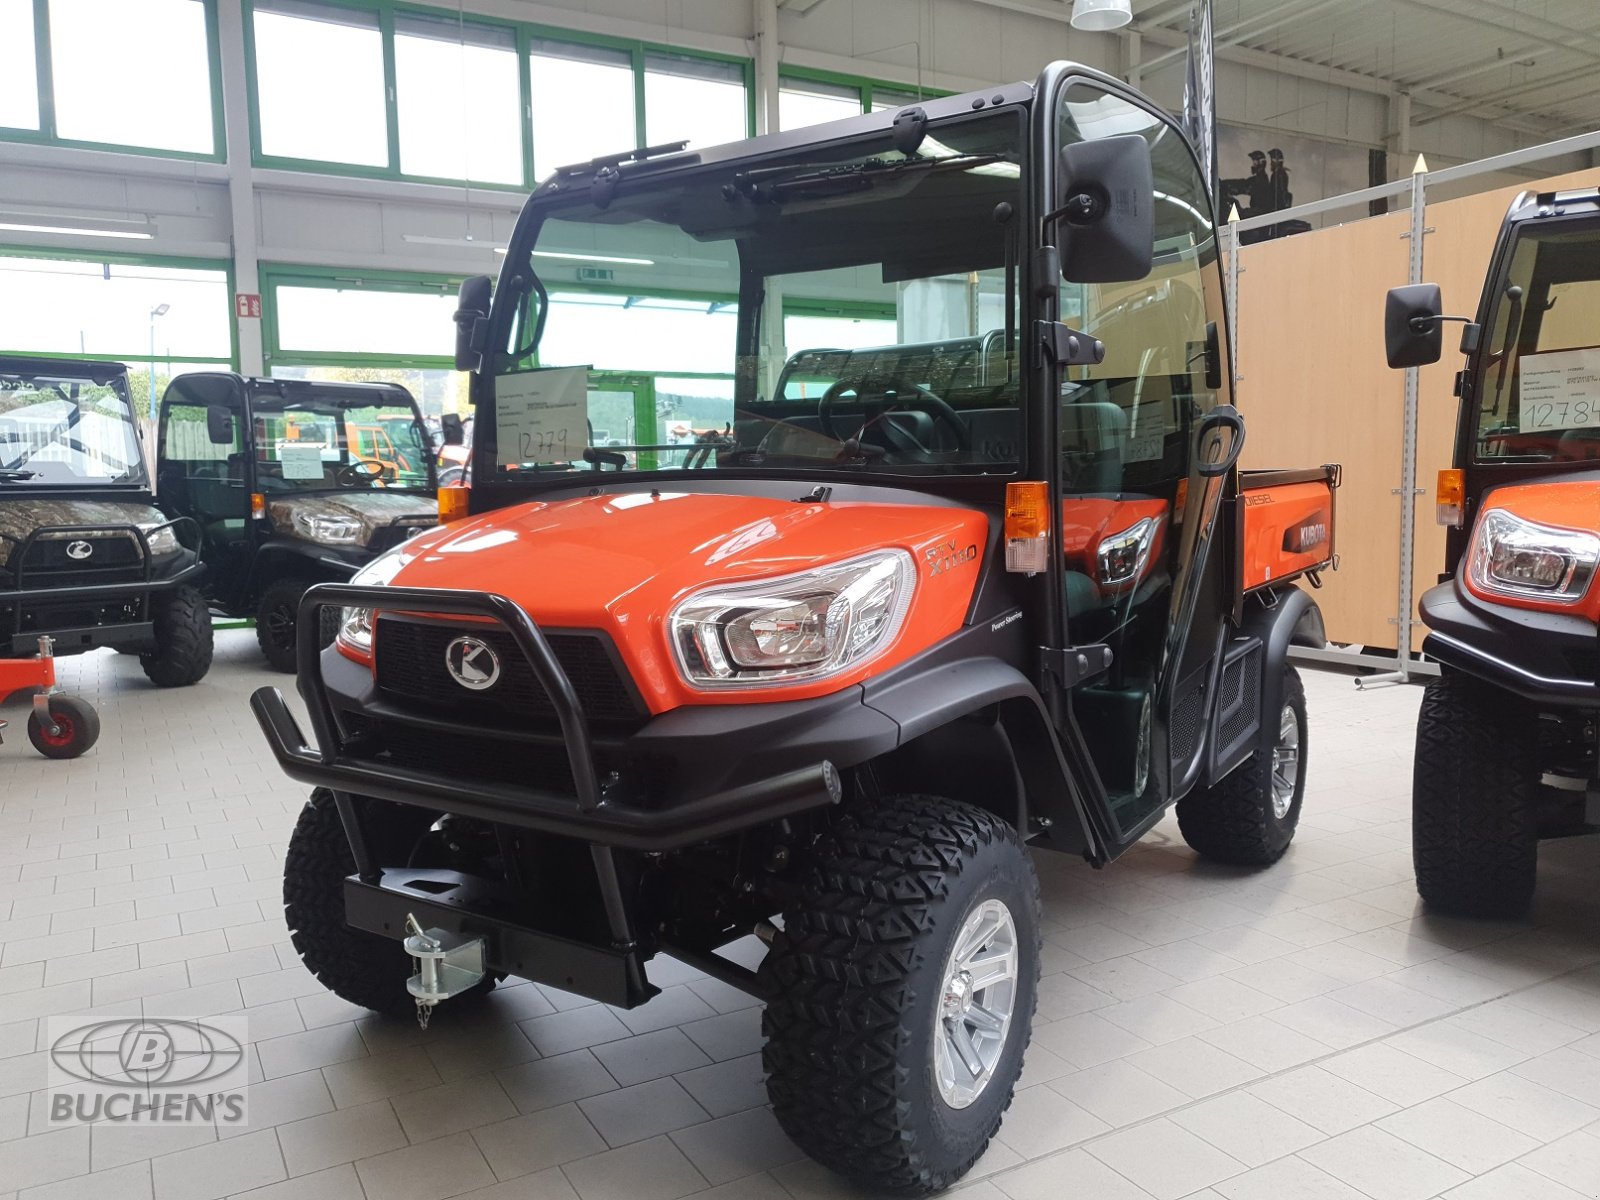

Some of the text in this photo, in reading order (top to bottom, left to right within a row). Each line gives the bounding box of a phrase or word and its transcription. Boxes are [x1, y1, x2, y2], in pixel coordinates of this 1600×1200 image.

[1524, 400, 1600, 428] 12784
[519, 428, 568, 460] 12779
[1245, 494, 1276, 507] DIESEL
[1300, 523, 1327, 547] KUBOTA
[926, 540, 956, 561] RTV
[991, 620, 1006, 633] Power
